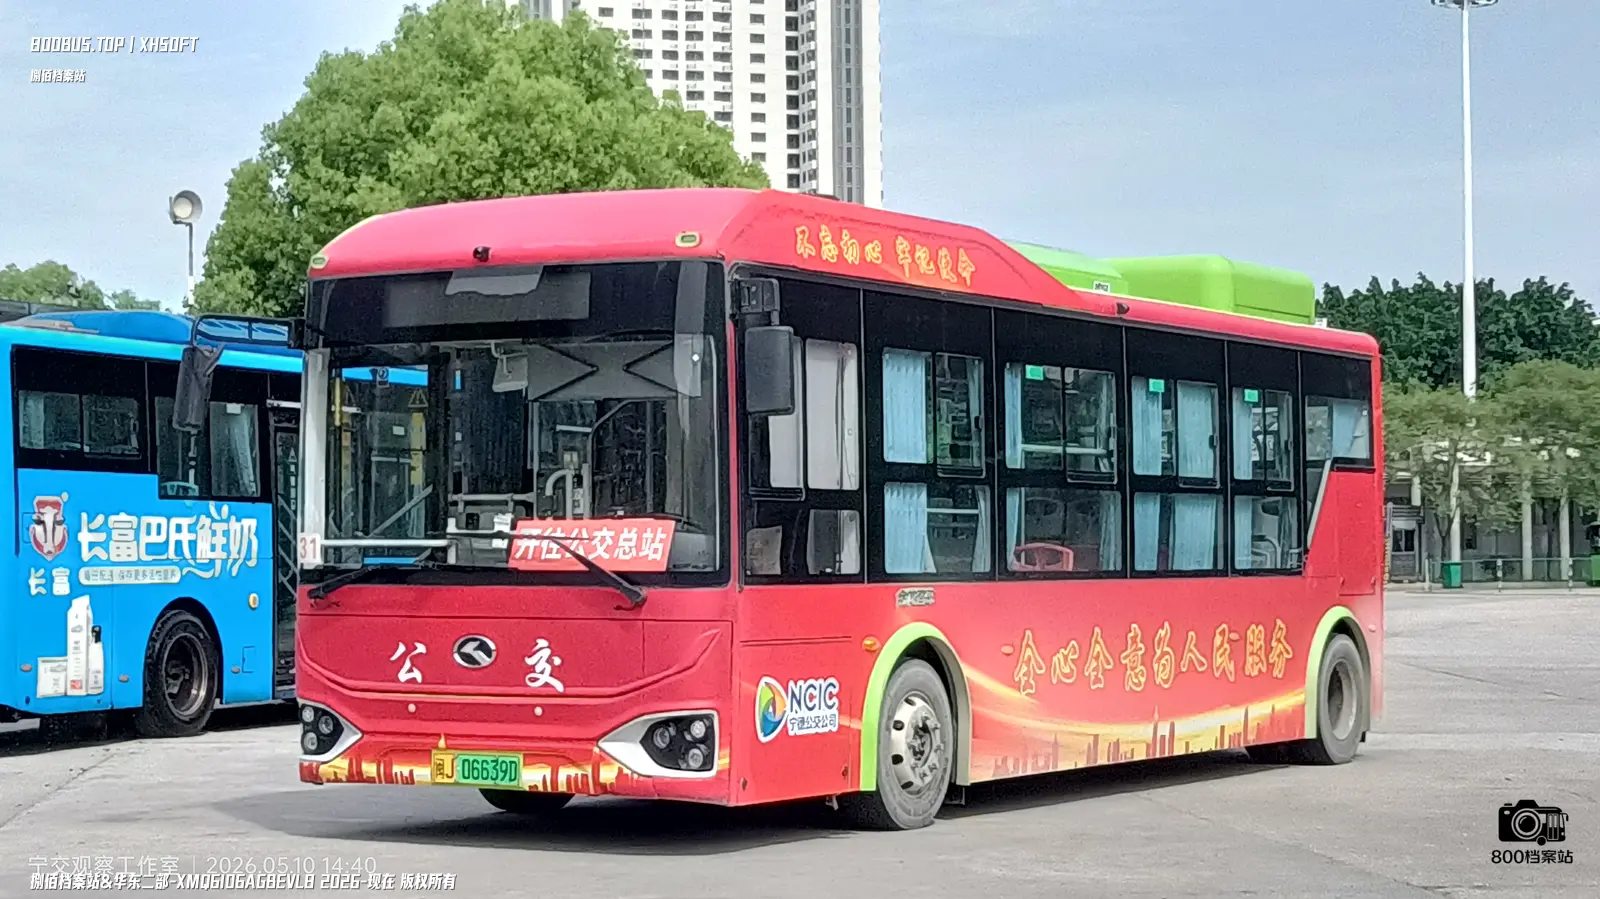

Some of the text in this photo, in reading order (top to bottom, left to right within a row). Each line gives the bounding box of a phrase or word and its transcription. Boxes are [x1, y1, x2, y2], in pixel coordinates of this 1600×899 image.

[78, 505, 259, 577] 长富巴氏鲜奶
[300, 537, 317, 560] 31
[514, 526, 667, 561] 开往公交总站
[28, 567, 71, 596] 长富
[389, 638, 566, 693] 公 交
[790, 682, 837, 713] NCIC
